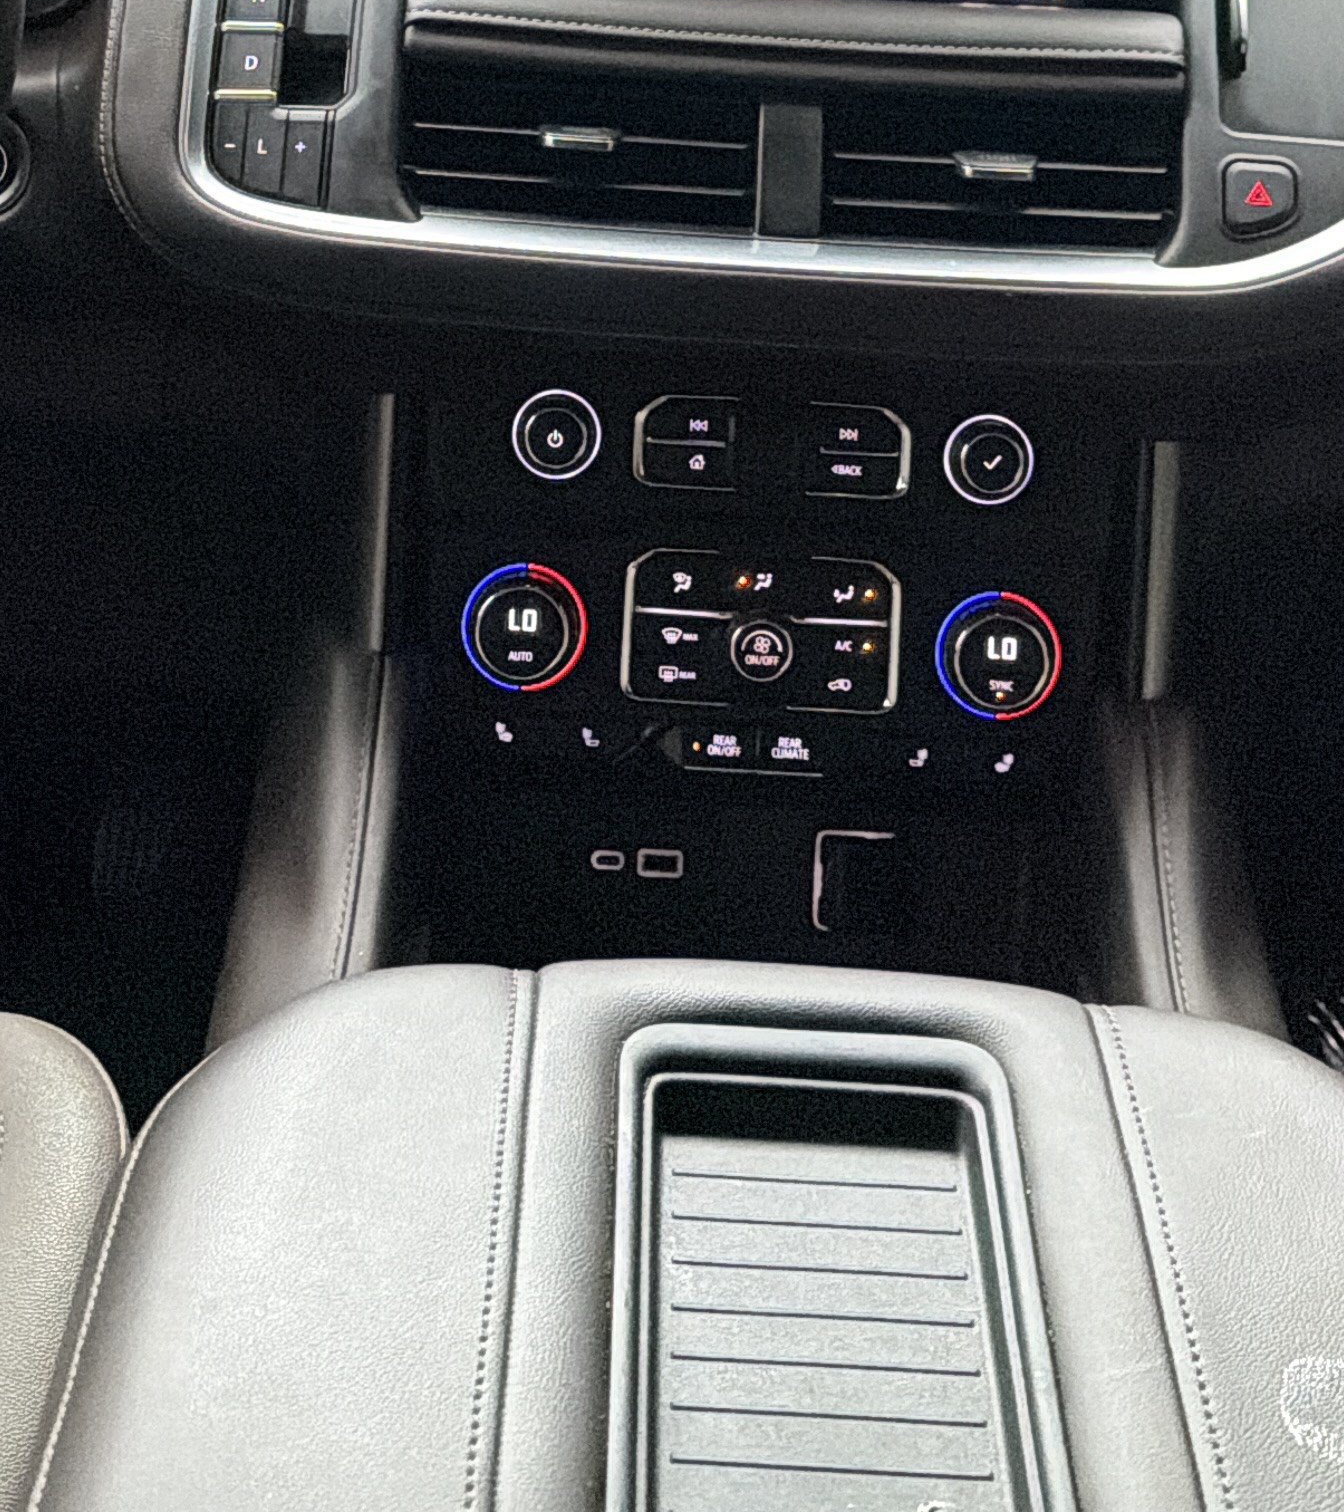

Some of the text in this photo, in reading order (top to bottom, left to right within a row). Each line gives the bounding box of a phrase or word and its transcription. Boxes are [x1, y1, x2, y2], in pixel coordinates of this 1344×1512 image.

[243, 55, 259, 71] D
[256, 138, 268, 155] L
[837, 465, 863, 476] BACK
[507, 607, 538, 633] LO
[834, 640, 853, 653] A/C
[986, 635, 1018, 662] LO
[507, 650, 534, 663] AUTO
[744, 654, 781, 667] ON/OFF
[712, 733, 738, 746] REAR
[777, 736, 803, 749] REAR
[706, 745, 743, 758] ON/OFF
[770, 748, 810, 762] CLIMATE
